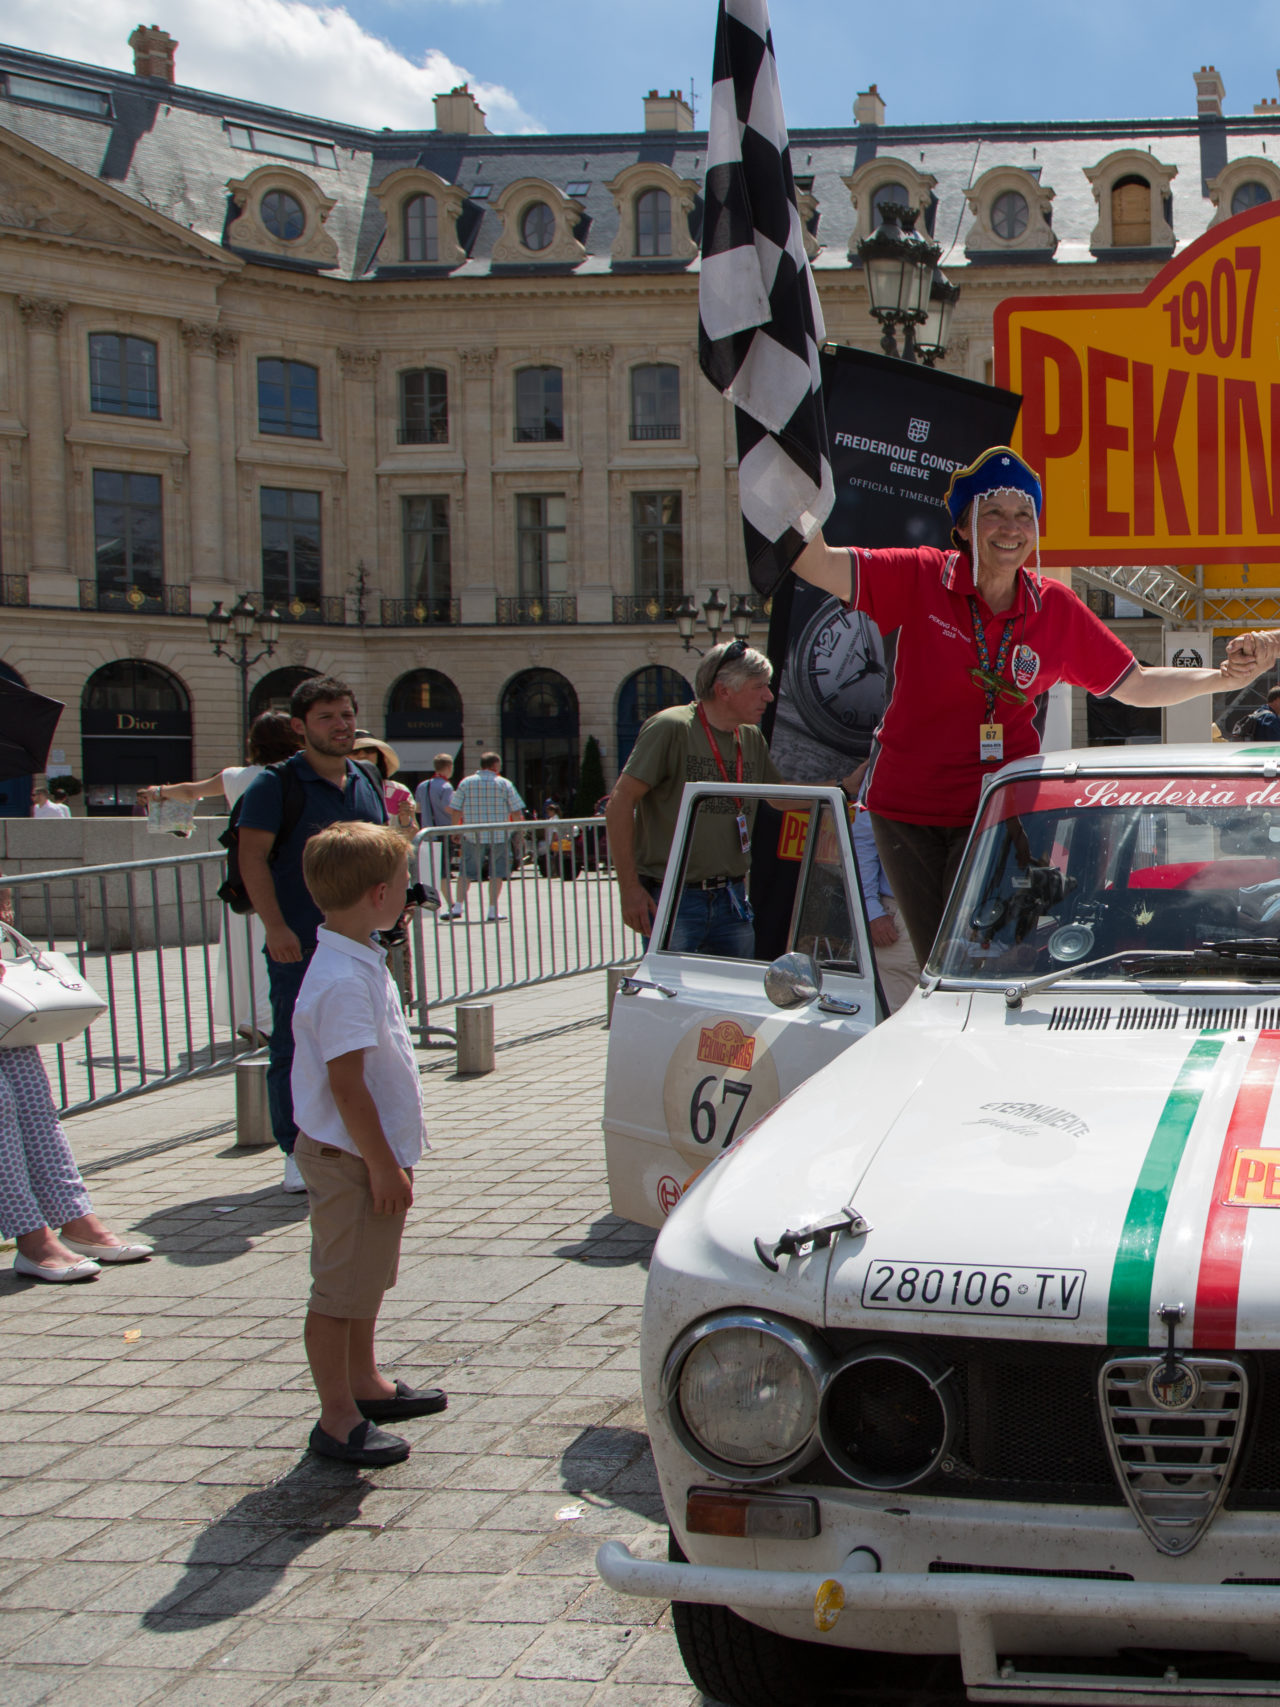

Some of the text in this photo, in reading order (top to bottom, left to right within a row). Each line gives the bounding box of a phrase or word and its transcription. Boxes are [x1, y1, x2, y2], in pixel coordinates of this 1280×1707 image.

[1163, 246, 1261, 359] 1907
[834, 432, 917, 463] FREDERIQUE
[889, 462, 930, 481] GENEVE
[850, 477, 947, 508] OFFICIAL TIMEKEEP
[928, 614, 950, 629] PEKING
[814, 628, 841, 657] 12
[1176, 658, 1199, 667] ERA
[116, 714, 159, 729] Dior
[986, 731, 996, 740] 67
[1074, 779, 1236, 808] Scuderia
[700, 1032, 727, 1061] PEKING
[728, 1042, 753, 1067] PARIS
[690, 1075, 752, 1149] 67
[979, 1102, 1090, 1138] ETERNAMENTE
[869, 1265, 1080, 1312] 280106 TV
